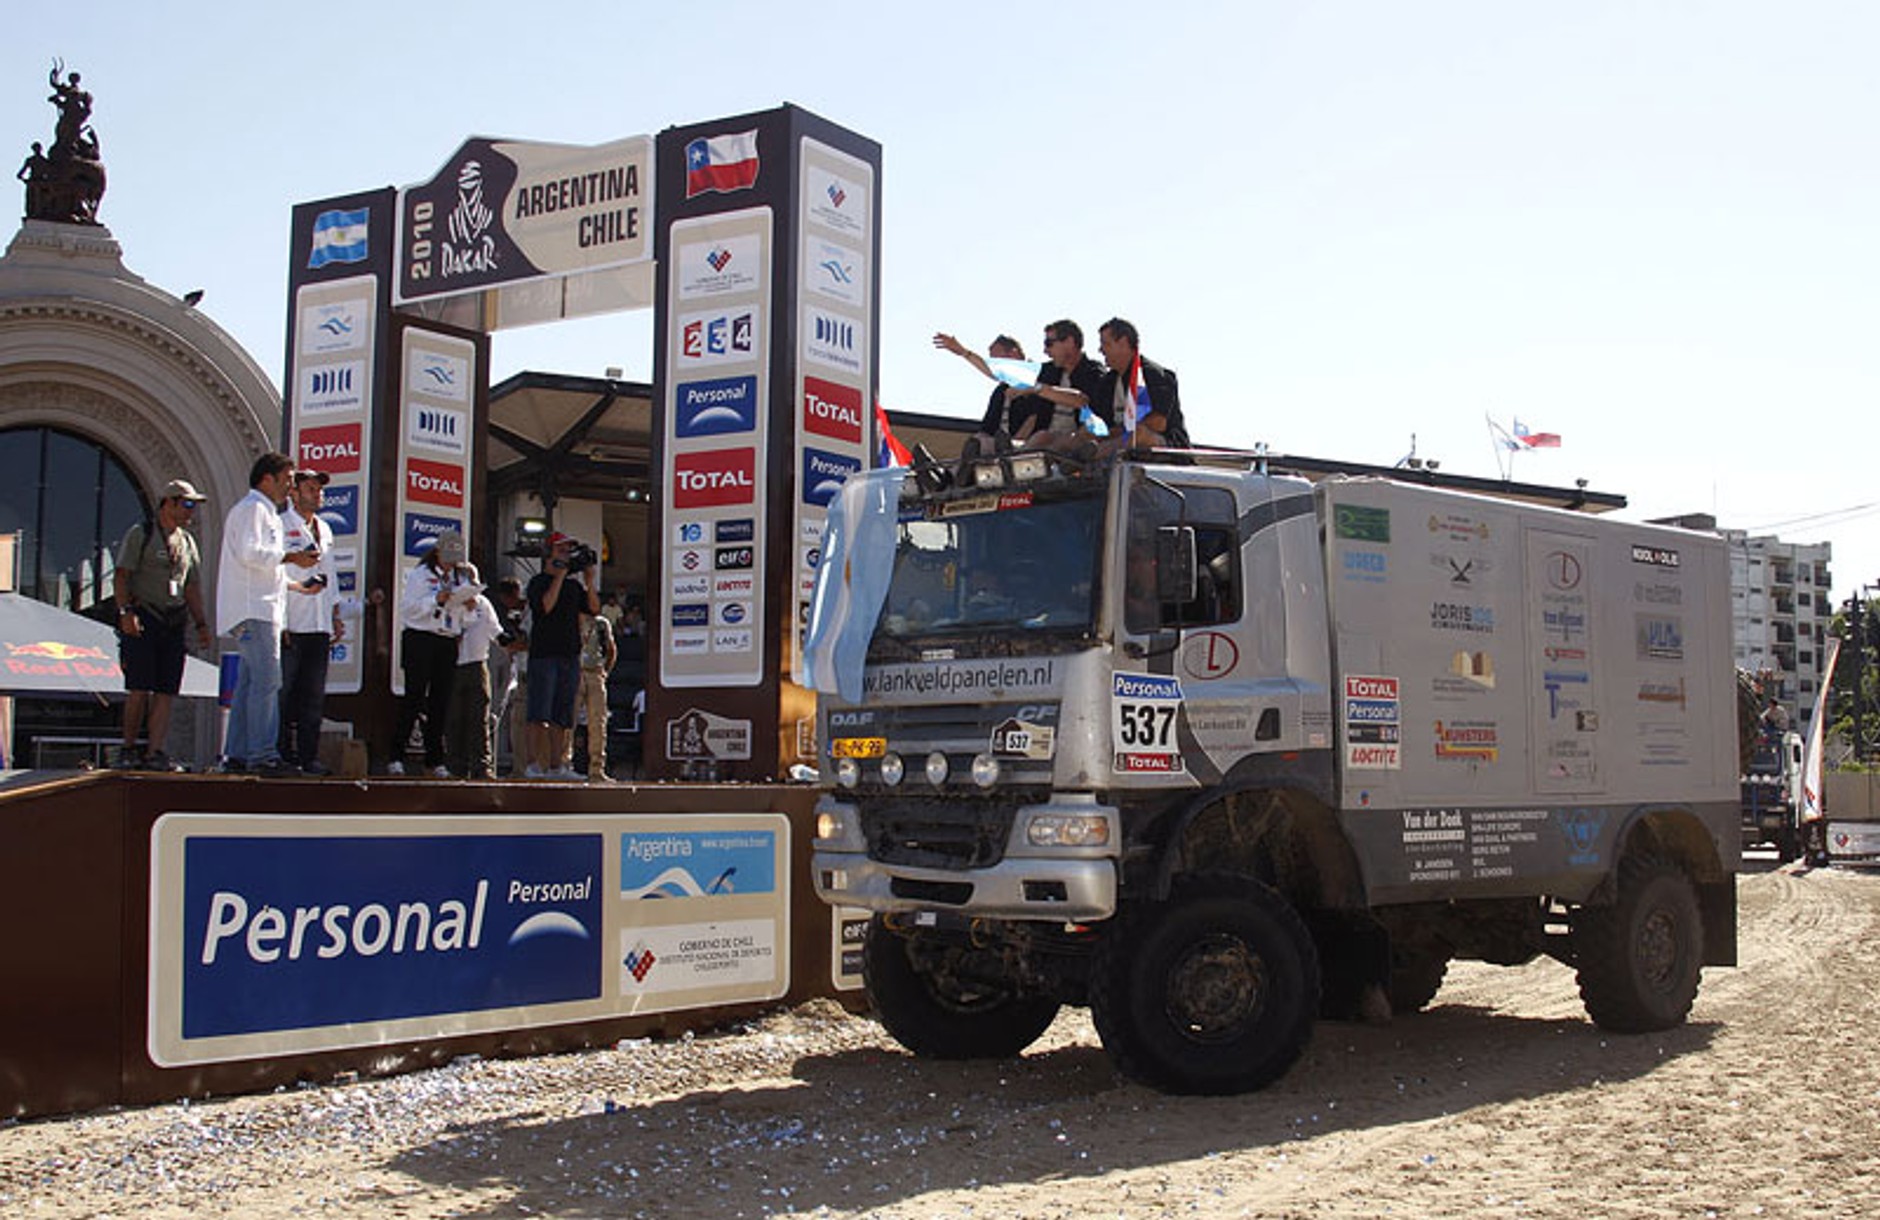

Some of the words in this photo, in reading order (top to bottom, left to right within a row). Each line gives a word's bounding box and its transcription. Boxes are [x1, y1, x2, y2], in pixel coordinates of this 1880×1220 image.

[516, 165, 639, 219] ARGENTINA
[578, 207, 639, 248] CHILE
[411, 202, 433, 279] 2010
[687, 383, 747, 404] Personal
[806, 394, 860, 426] TOTAL
[300, 443, 359, 460] TOTAL
[408, 471, 462, 495] TOTAL
[677, 469, 752, 490] TOTAL
[1431, 602, 1472, 622] JORIS
[4, 659, 71, 676] Red
[1116, 678, 1179, 697] Personal
[1349, 679, 1395, 696] TOTAL
[831, 712, 875, 726] DAF
[1016, 705, 1058, 720] CF
[1349, 703, 1397, 719] Personal
[1120, 704, 1175, 746] 537
[1008, 734, 1029, 749] 537
[1128, 756, 1169, 769] TOTAL
[1352, 748, 1397, 764] LOCTITE
[627, 836, 693, 861] Argentina
[507, 876, 592, 903] Personal
[201, 879, 489, 965] Personal
